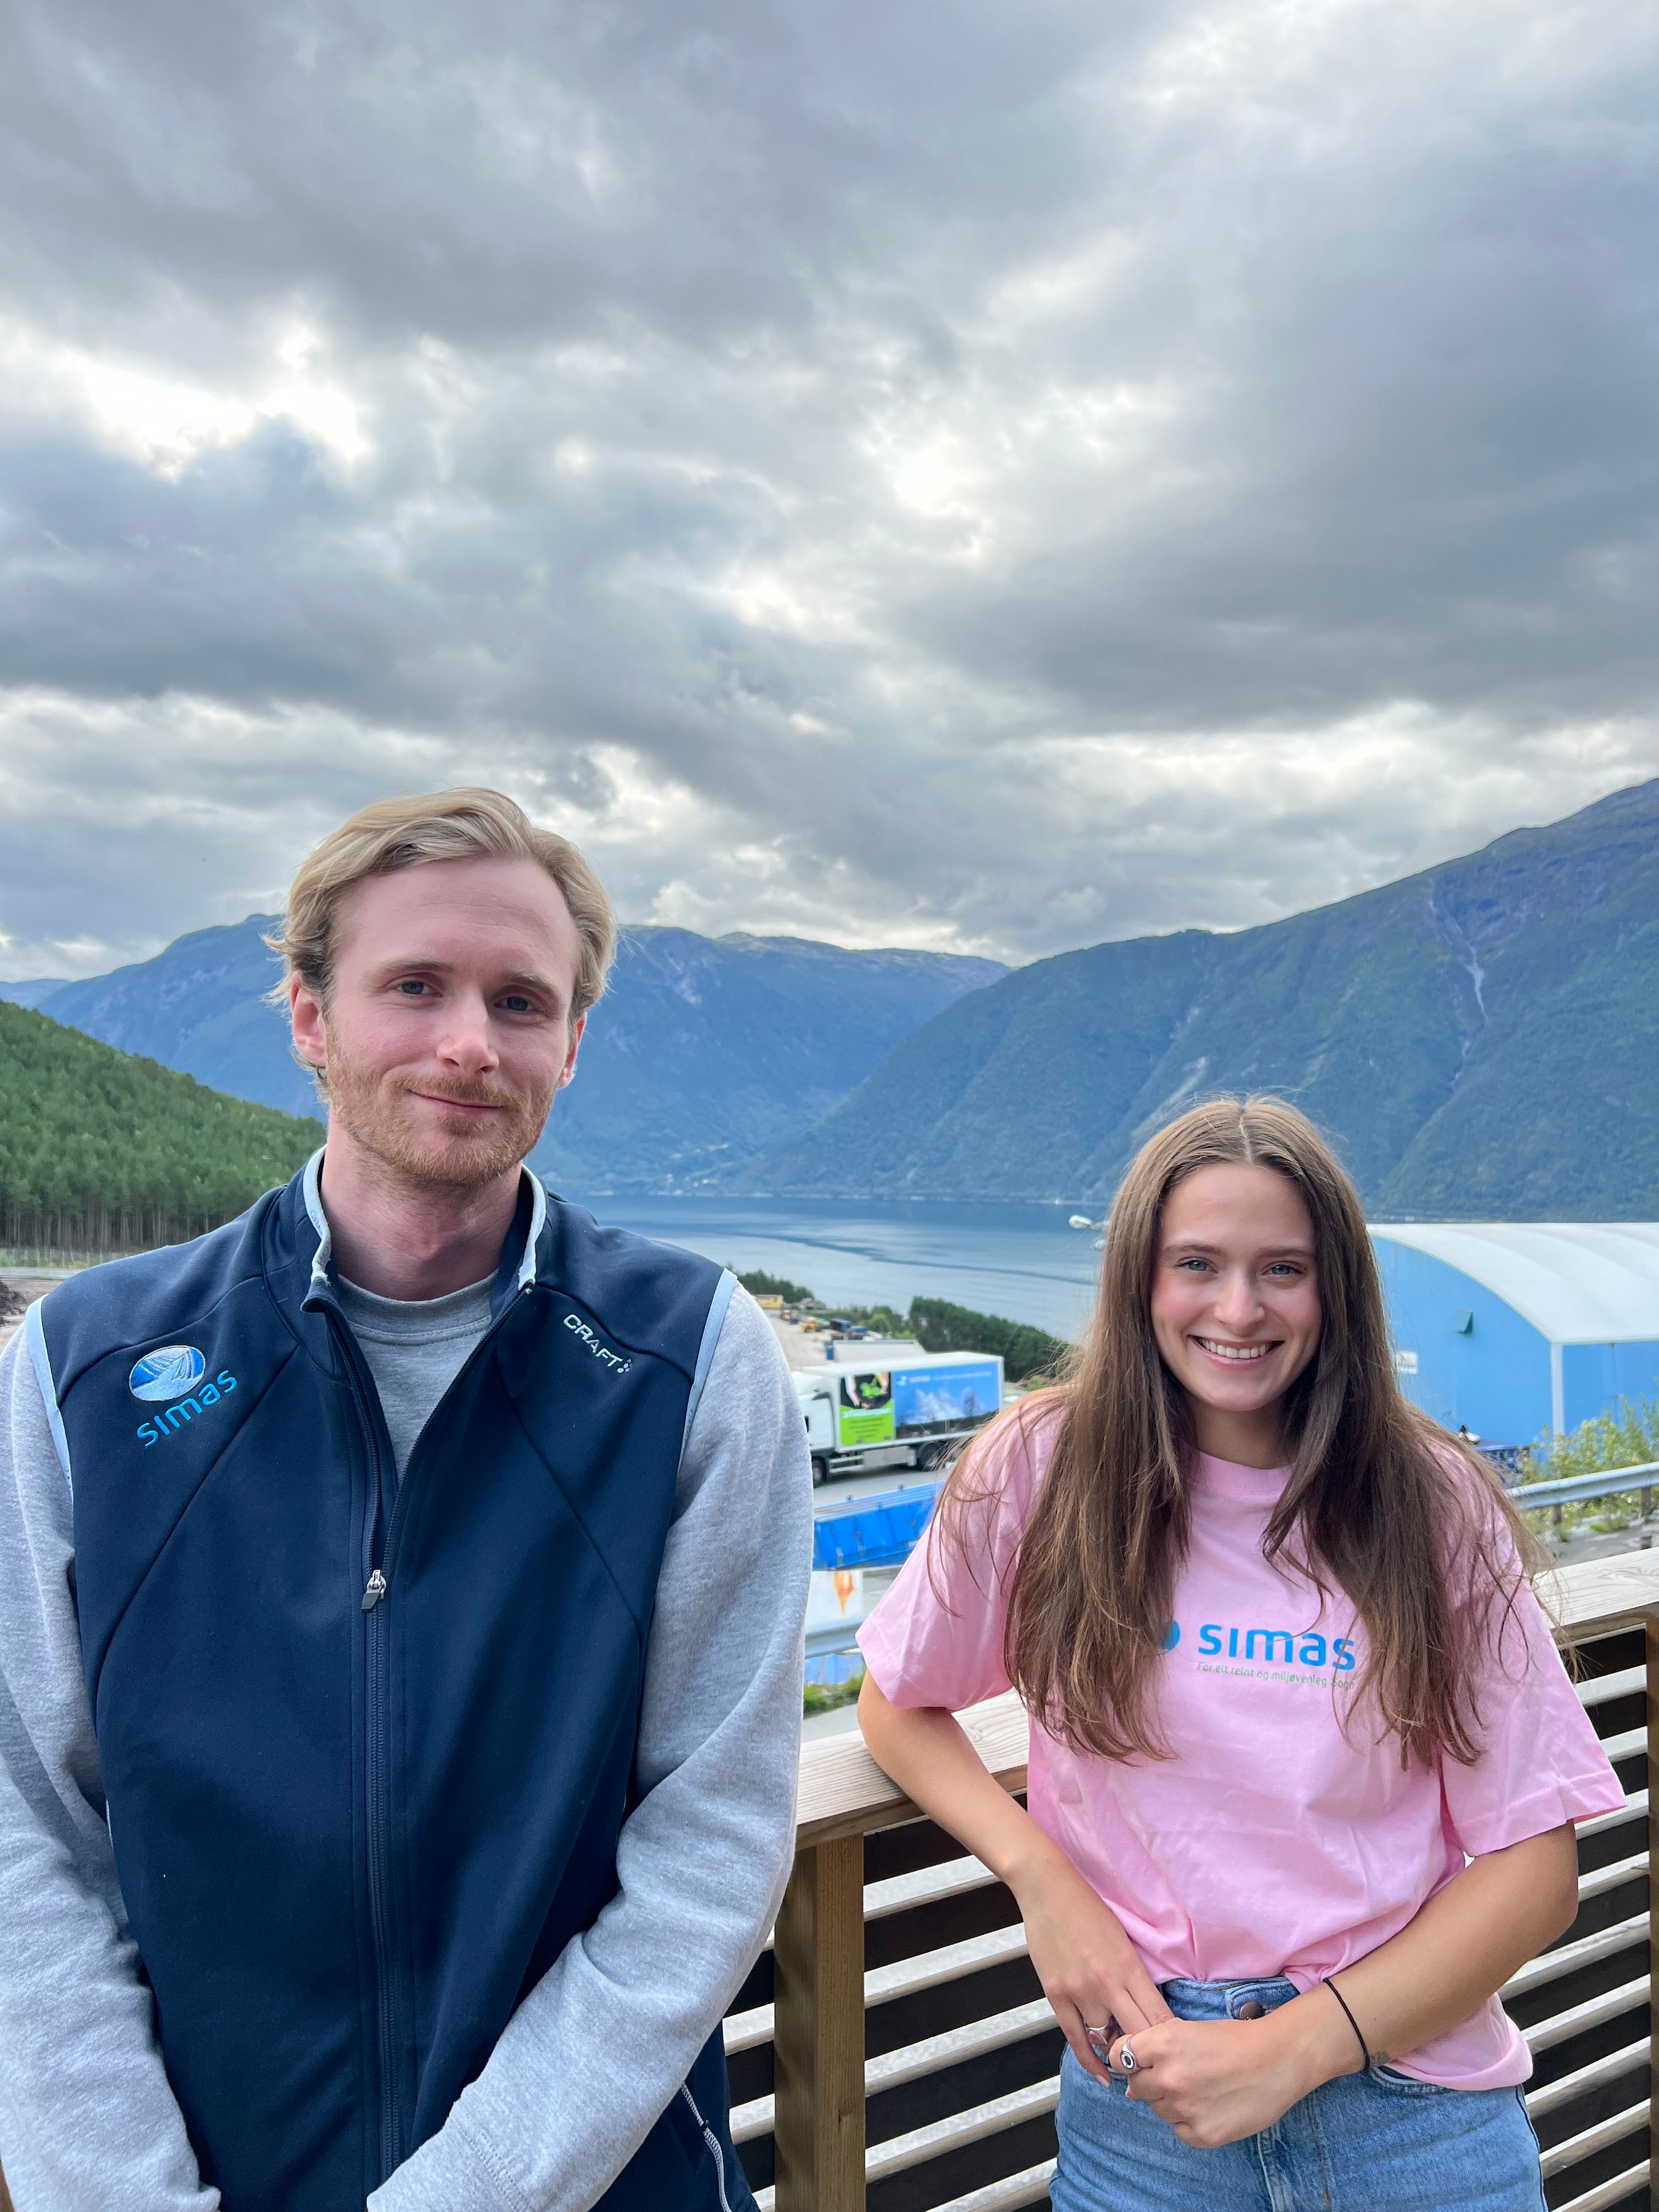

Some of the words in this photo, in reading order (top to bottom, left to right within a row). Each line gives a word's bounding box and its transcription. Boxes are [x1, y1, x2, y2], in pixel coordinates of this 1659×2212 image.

[563, 1314, 623, 1367] CRAFT
[137, 1370, 238, 1448] simas
[1197, 1624, 1356, 1671] simas
[1197, 1661, 1213, 1672] For
[1215, 1664, 1228, 1674] eit
[1231, 1667, 1254, 1677] reint
[1256, 1671, 1269, 1681] og
[1271, 1671, 1327, 1689] miljøvenleg
[1331, 1677, 1355, 1691] Sogn
